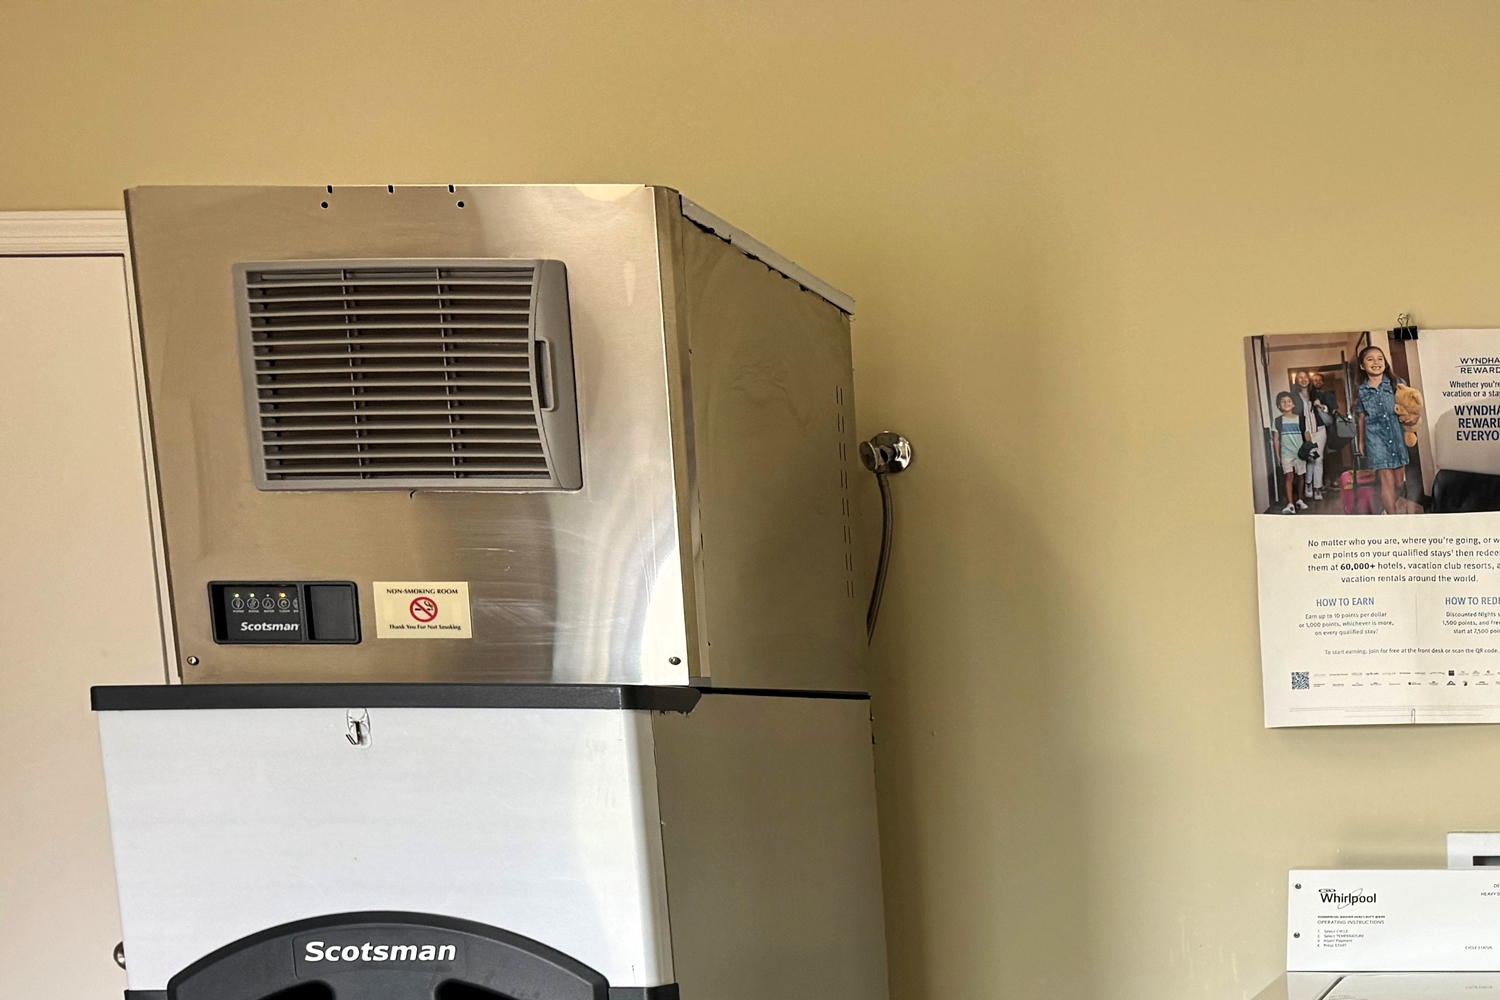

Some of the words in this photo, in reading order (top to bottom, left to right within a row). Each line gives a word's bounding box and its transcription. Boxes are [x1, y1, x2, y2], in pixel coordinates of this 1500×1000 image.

[1429, 537, 1453, 545] you're
[1456, 537, 1481, 545] going,
[1333, 551, 1358, 559] points
[1393, 549, 1428, 557] qualified
[1340, 563, 1375, 571] 60,000+
[1378, 562, 1406, 570] hotels,
[1316, 598, 1336, 607] HOW
[1338, 598, 1349, 606] TO
[1352, 597, 1374, 606] EARN
[1445, 597, 1466, 605] HOW
[1468, 597, 1479, 605] TO
[240, 622, 299, 631] Scotsman
[1320, 893, 1376, 906] Whirlpool
[305, 941, 456, 962] Scotsman
